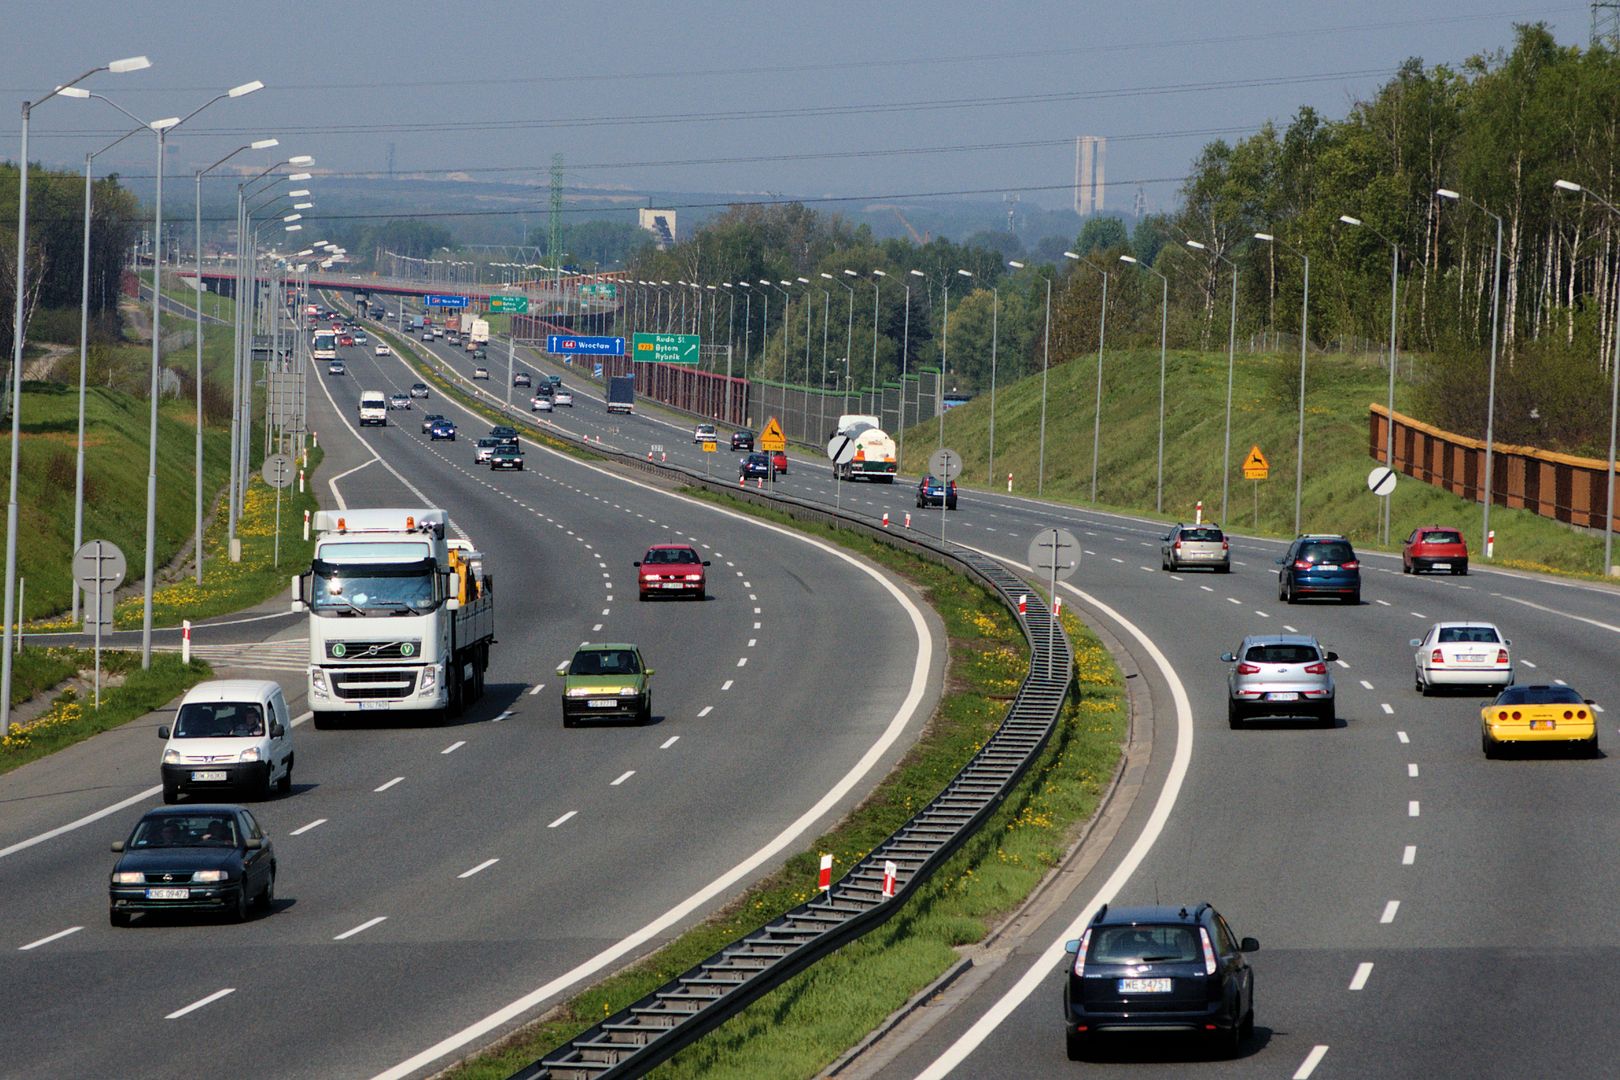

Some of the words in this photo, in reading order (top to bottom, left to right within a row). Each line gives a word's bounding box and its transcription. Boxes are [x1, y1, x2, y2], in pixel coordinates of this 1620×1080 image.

[655, 343, 679, 352] Bytom
[655, 352, 680, 361] Rybnik
[1125, 979, 1138, 989] WE
